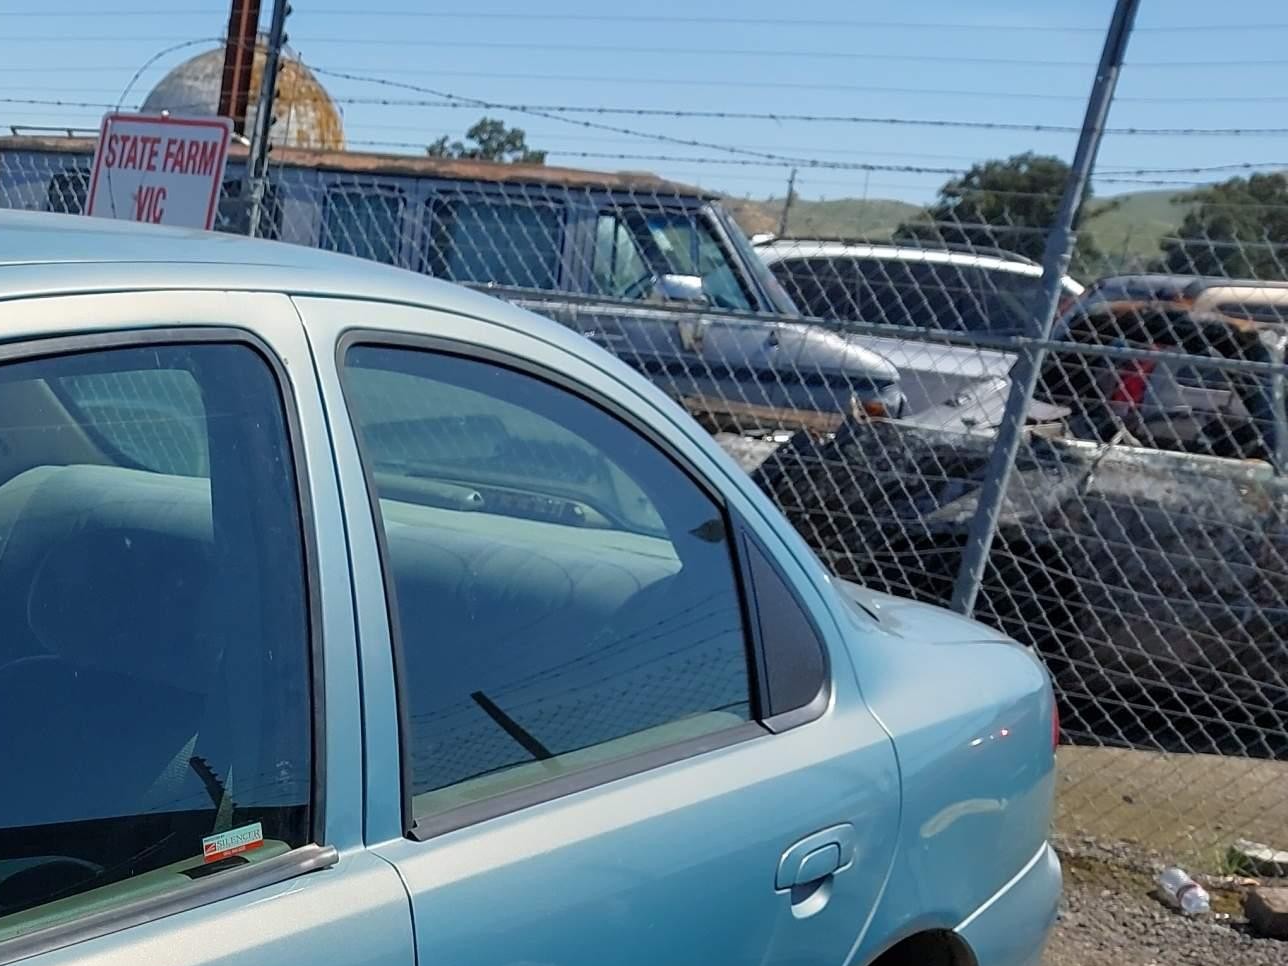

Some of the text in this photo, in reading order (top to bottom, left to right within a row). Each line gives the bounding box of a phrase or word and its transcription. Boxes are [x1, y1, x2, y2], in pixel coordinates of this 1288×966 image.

[105, 133, 218, 177] STATE FARM
[135, 185, 167, 224] VIC
